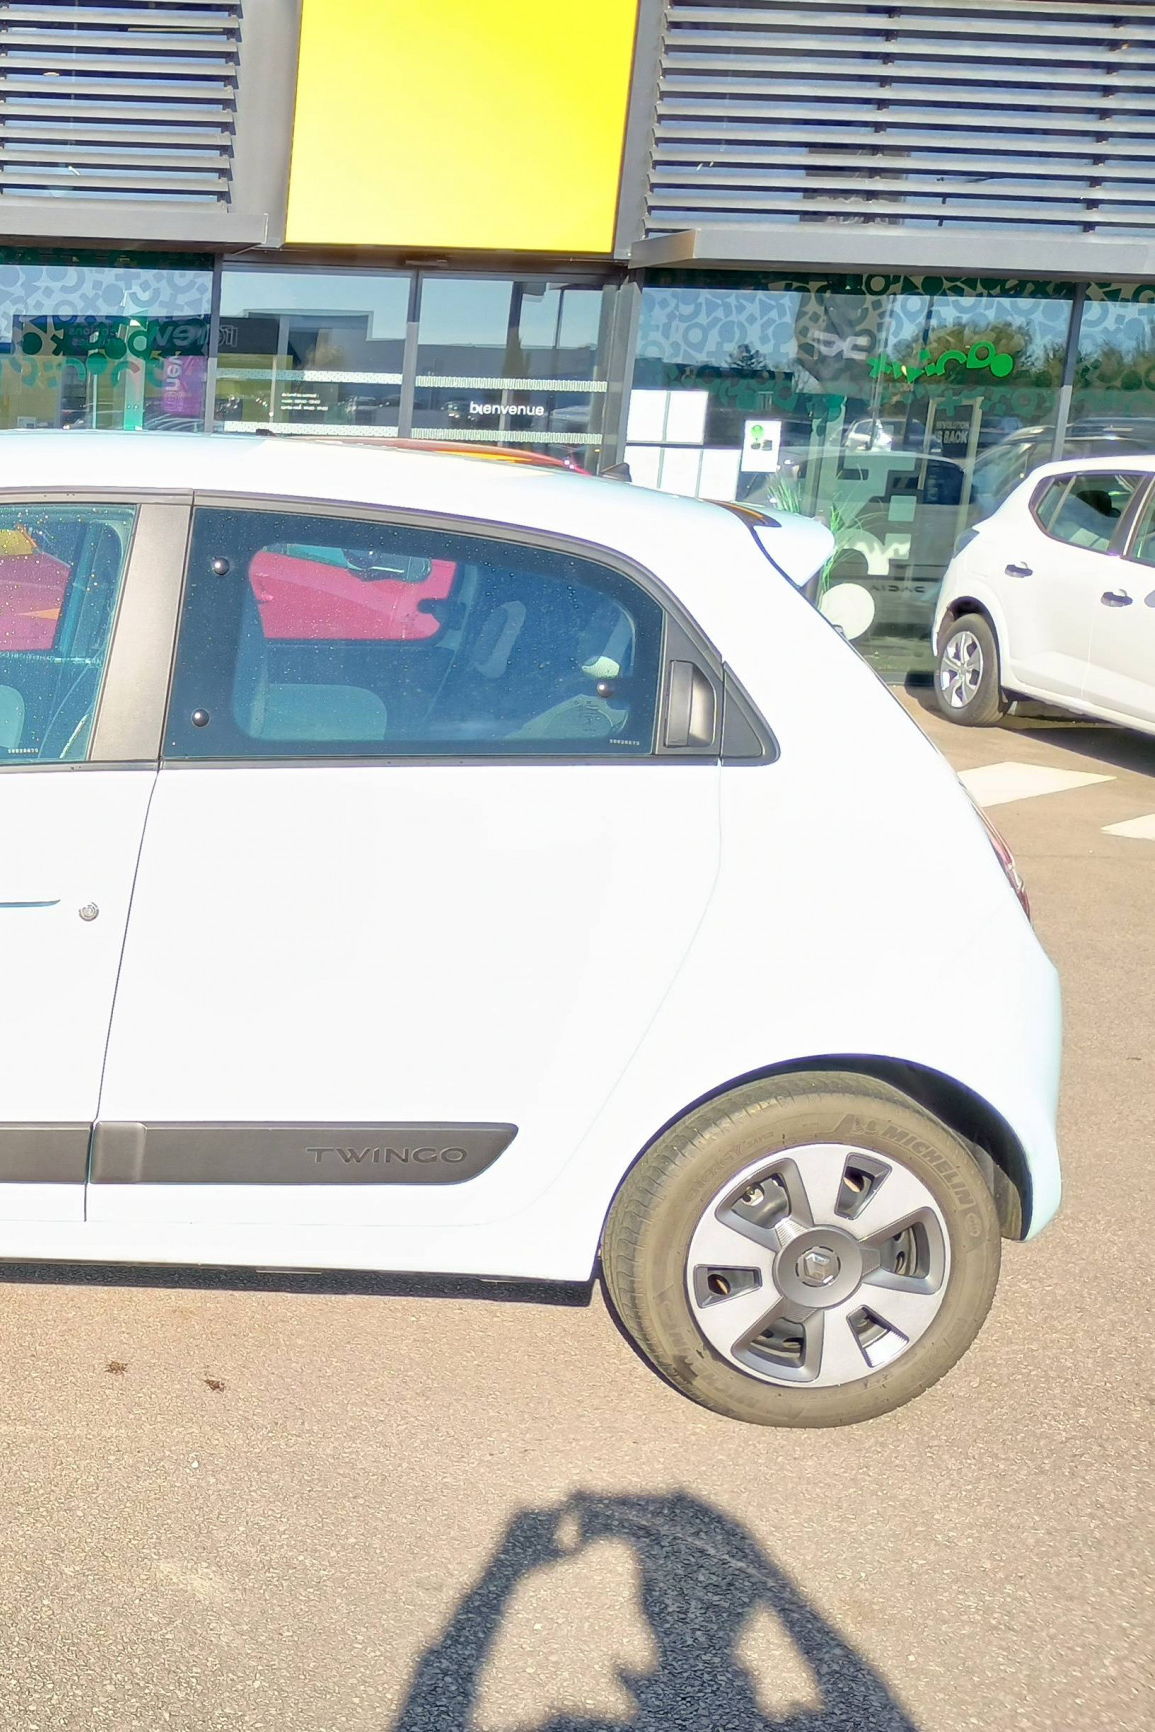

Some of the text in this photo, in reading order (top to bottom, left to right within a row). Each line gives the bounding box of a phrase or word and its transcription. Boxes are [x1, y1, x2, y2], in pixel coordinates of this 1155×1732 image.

[469, 401, 545, 416] bienvenue
[943, 430, 969, 444] BACK
[306, 1146, 468, 1164] TWINGO
[880, 1125, 976, 1207] MICHELIN
